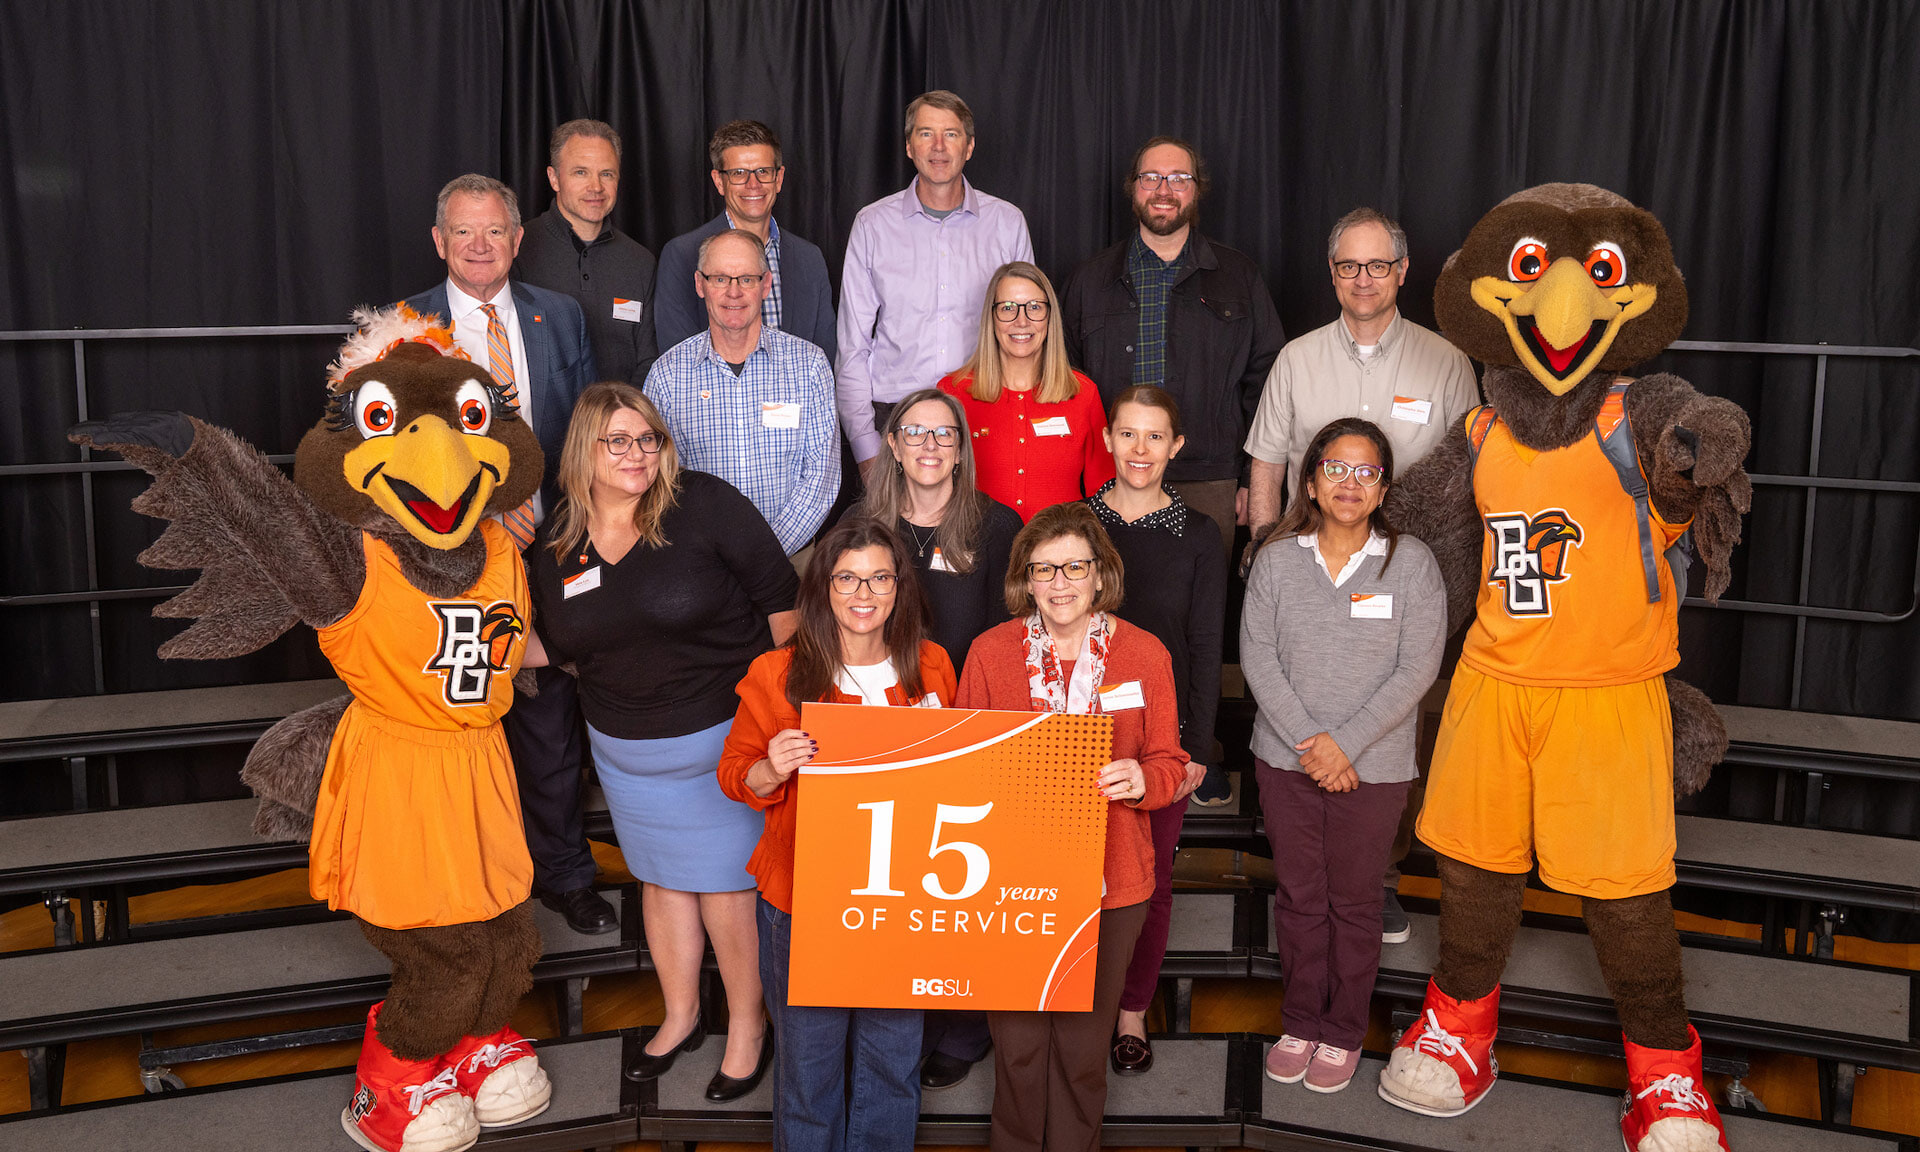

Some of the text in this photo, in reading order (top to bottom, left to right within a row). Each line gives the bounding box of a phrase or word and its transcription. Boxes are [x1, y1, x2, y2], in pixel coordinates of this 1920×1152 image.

[1488, 518, 1545, 613] BG
[434, 605, 491, 702] BG
[851, 800, 994, 900] 15
[995, 885, 1058, 905] years
[841, 906, 1057, 935] OF SERVICE
